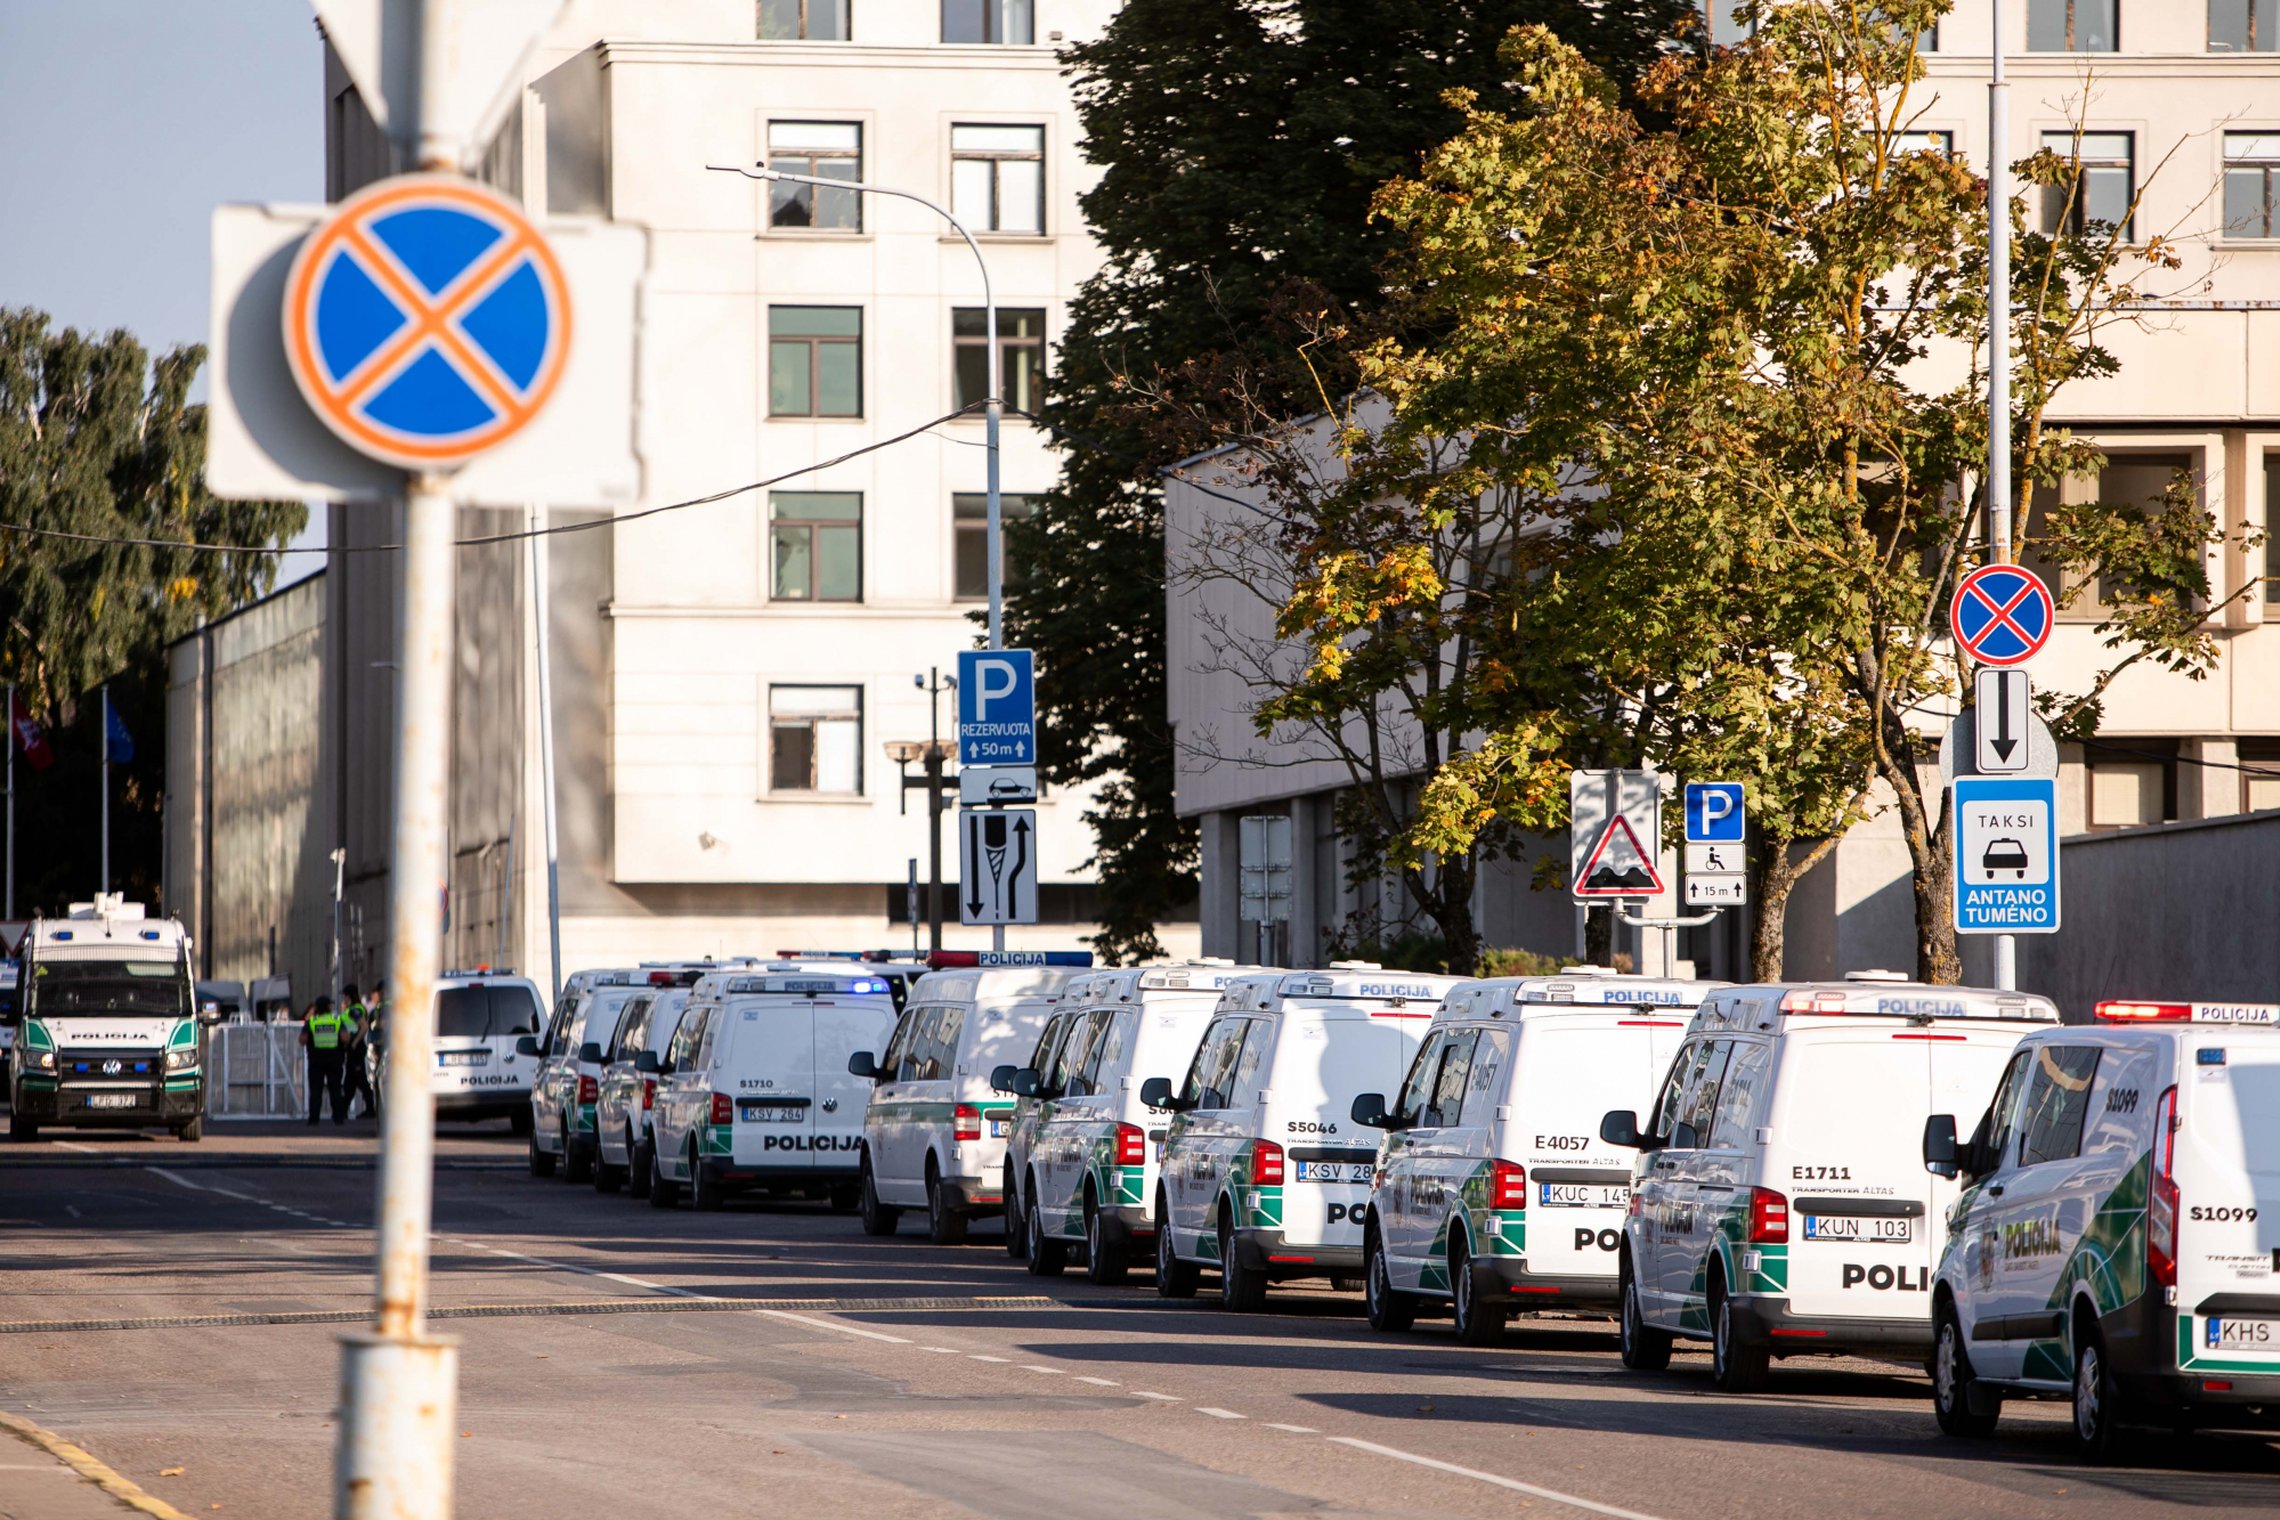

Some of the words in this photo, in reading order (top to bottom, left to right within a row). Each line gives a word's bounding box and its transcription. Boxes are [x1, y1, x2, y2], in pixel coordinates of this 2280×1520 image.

[975, 659, 1018, 721] P
[961, 723, 1031, 736] REZERVUOTA
[981, 742, 998, 755] 50
[999, 744, 1012, 755] m
[1702, 790, 1733, 835] P
[1978, 815, 2034, 828] TAKSI
[1704, 886, 1716, 896] 15
[1718, 888, 1728, 896] m
[1966, 889, 2047, 905] ANTANO
[980, 953, 1043, 966] POLICIJA
[785, 981, 835, 992] POLICIJA
[1360, 984, 1431, 998] POLICIJA
[1604, 991, 1681, 1005] POLICIJA
[1878, 999, 1965, 1016] POLICIJA
[2201, 1007, 2269, 1021] POLICIJA
[740, 1080, 774, 1089] S1710
[2105, 1087, 2139, 1113] S1099
[750, 1108, 773, 1120] KSV
[780, 1108, 801, 1120] 264
[1288, 1121, 1338, 1134] S5046
[764, 1135, 863, 1151] POLICIJA
[1535, 1135, 1590, 1151] E4057
[1528, 1157, 1590, 1165] TRANSPORTER
[1592, 1157, 1621, 1166] ALTAS
[1308, 1164, 1342, 1178] KSV
[1353, 1165, 1371, 1179] 28
[1792, 1166, 1851, 1180] E1711
[1552, 1186, 1589, 1202] KUC
[1791, 1186, 1860, 1194] TRANSPORTER
[1862, 1186, 1895, 1195] ALTAS
[2190, 1206, 2258, 1223] S1099
[1818, 1218, 1859, 1235] KUN
[1875, 1220, 1907, 1237] 103
[2005, 1219, 2061, 1259] POLICIJA
[1842, 1263, 1929, 1292] POLI
[2223, 1322, 2270, 1342] KHS
